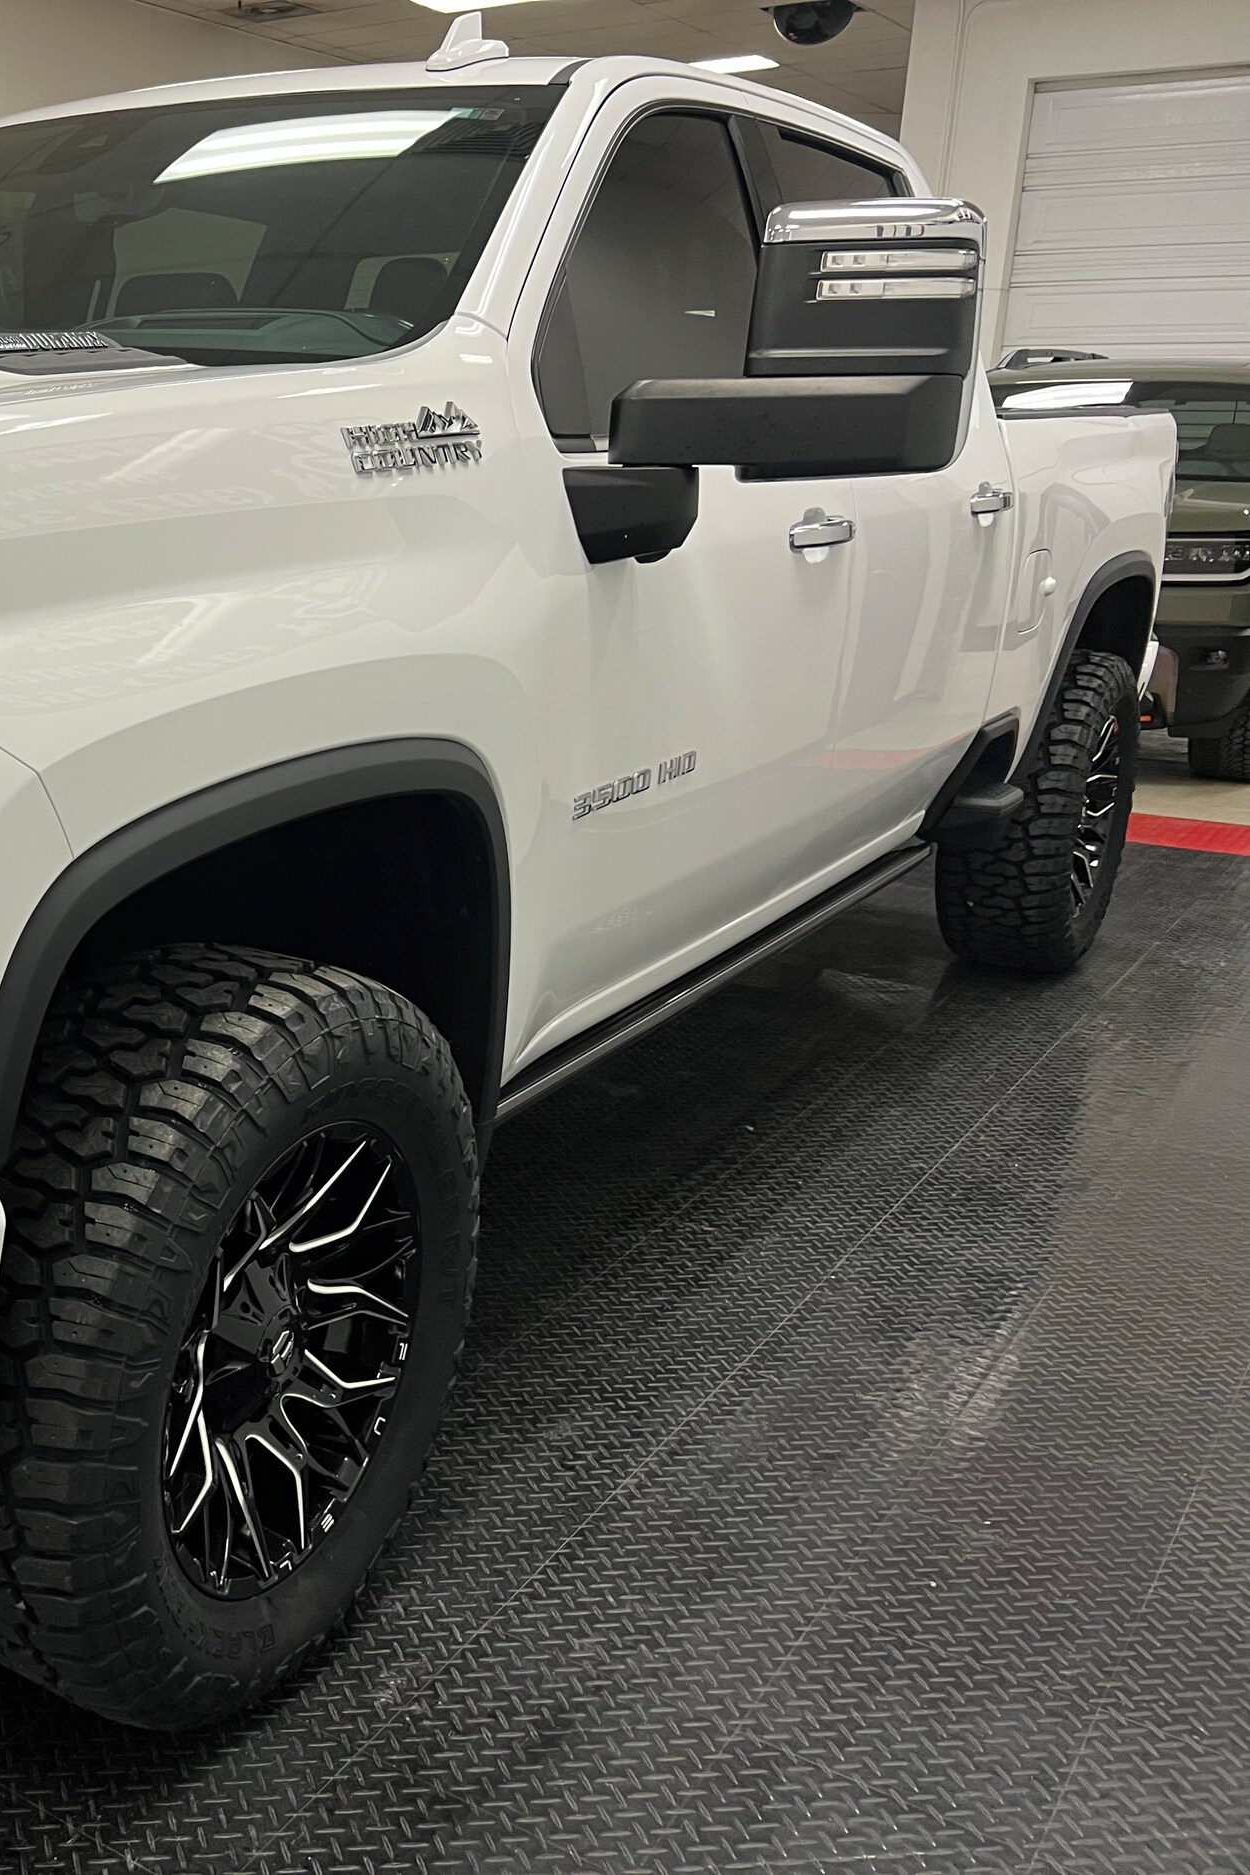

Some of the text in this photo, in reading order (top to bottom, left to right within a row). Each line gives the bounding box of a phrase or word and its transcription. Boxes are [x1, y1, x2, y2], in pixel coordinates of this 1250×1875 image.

[350, 440, 483, 475] COUNTRY
[572, 750, 697, 821] 3500 HD
